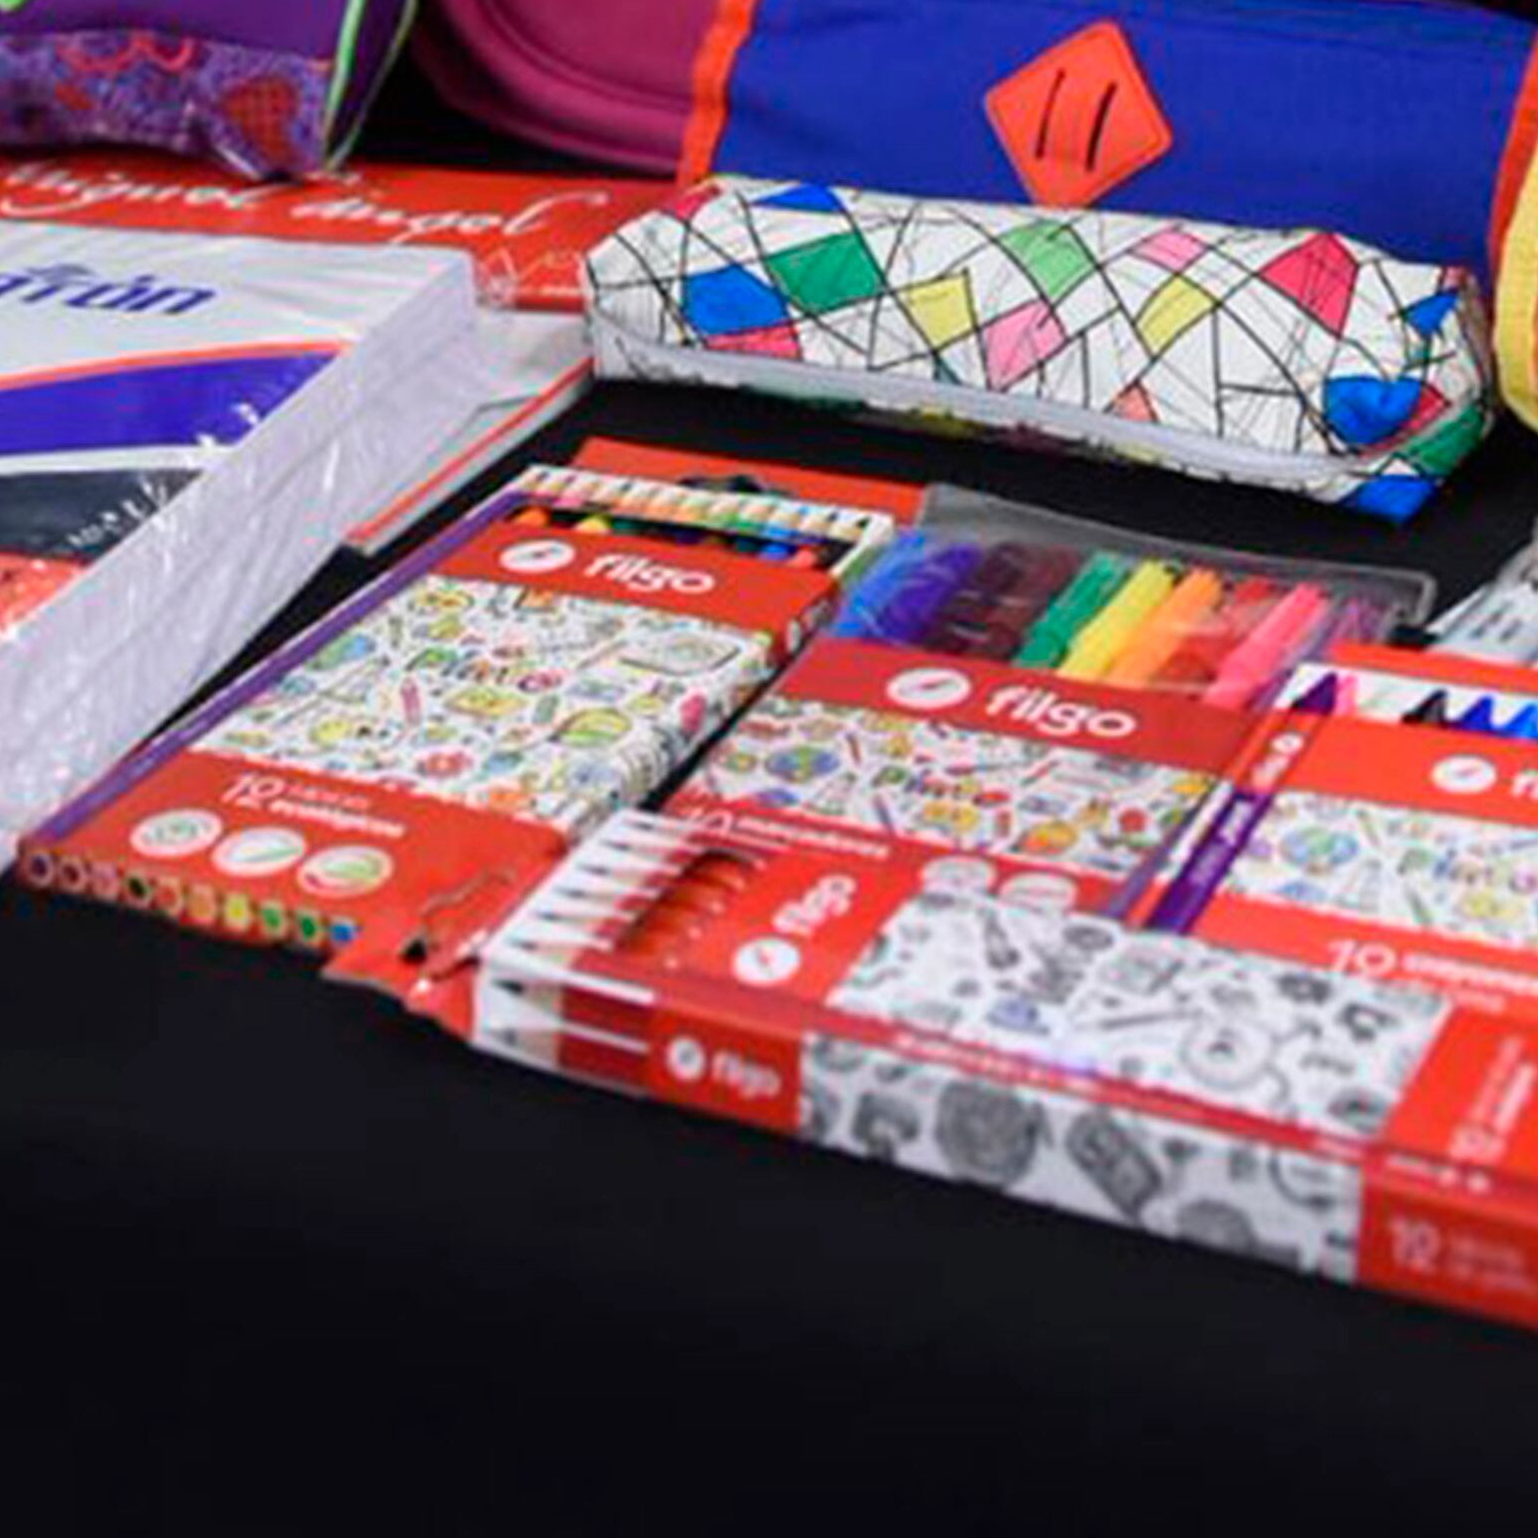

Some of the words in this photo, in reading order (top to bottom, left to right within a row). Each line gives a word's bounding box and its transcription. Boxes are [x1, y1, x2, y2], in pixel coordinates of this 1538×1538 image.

[583, 552, 716, 594] filgo
[984, 685, 1137, 737] filgo
[1327, 939, 1396, 978] 10
